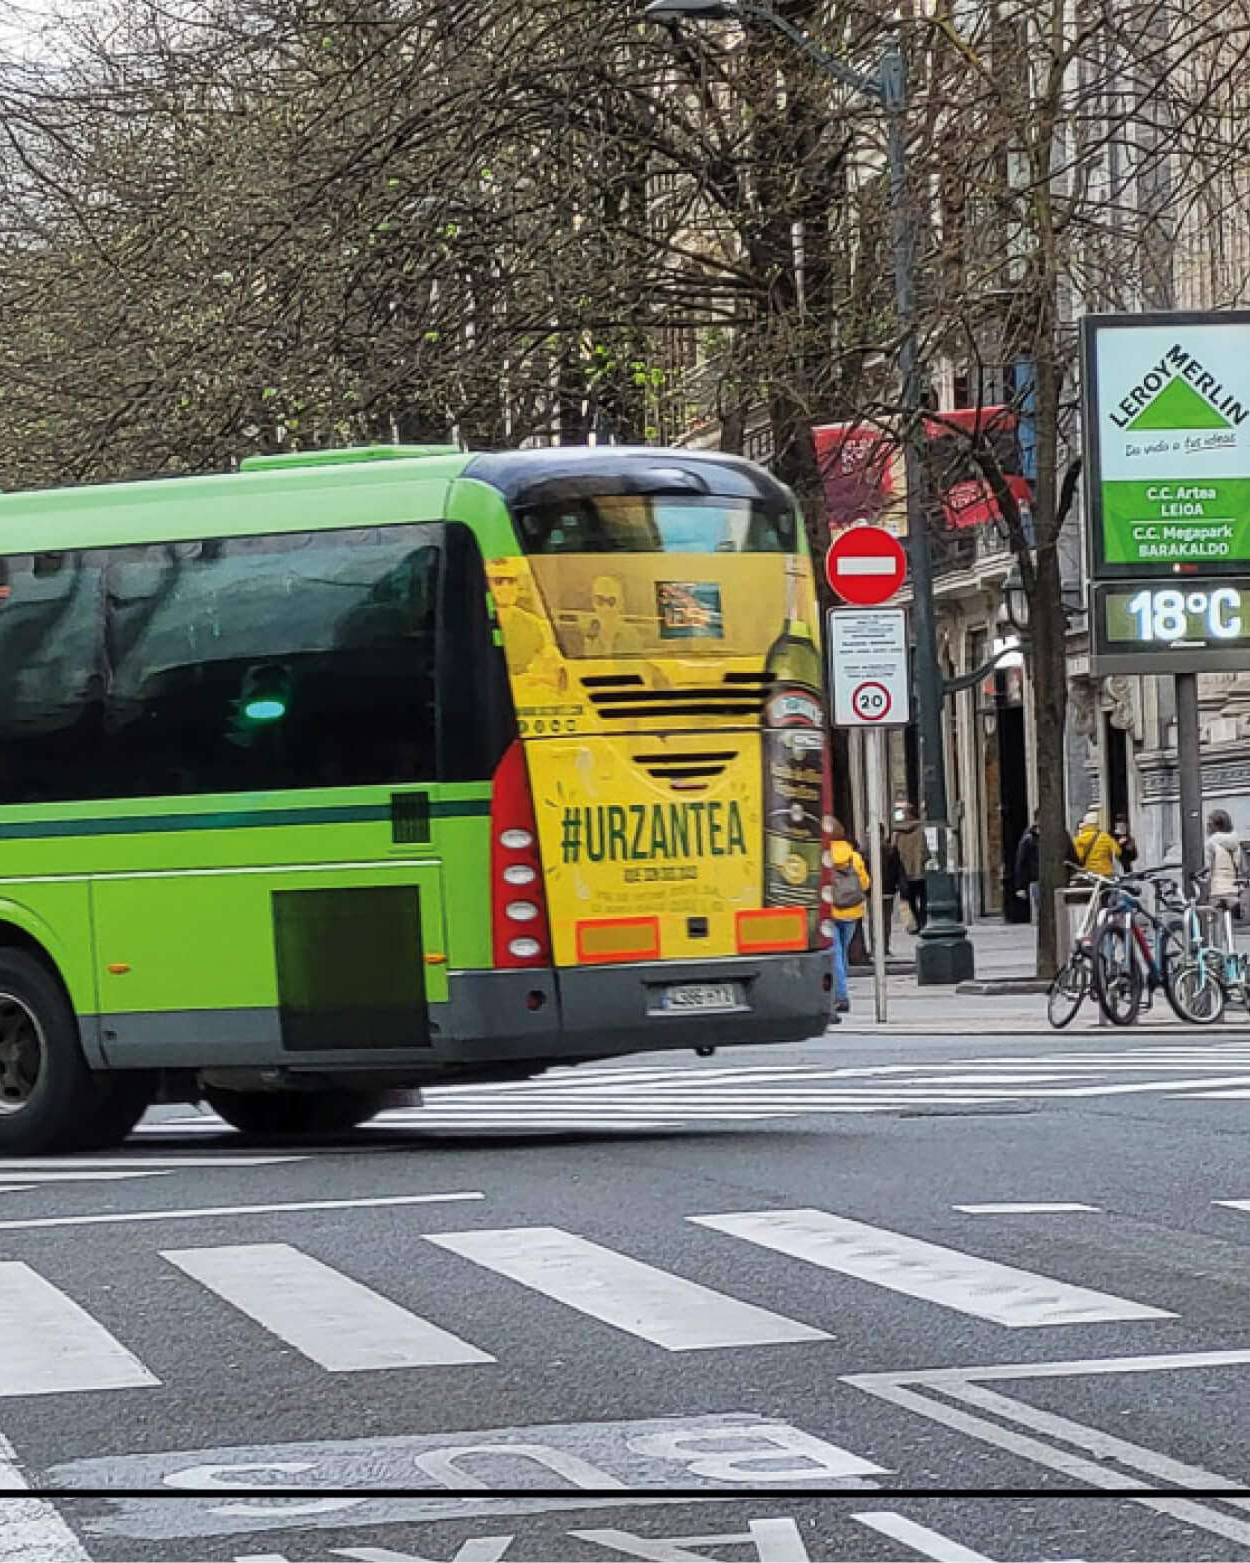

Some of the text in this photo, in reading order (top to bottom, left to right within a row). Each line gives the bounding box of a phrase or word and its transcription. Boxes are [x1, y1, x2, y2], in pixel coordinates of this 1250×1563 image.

[1109, 359, 1172, 429] LEROY
[1166, 344, 1250, 427] MERLIN
[1146, 486, 1216, 500] C.C. Artea
[1161, 502, 1204, 517] LEIOA
[1133, 524, 1233, 542] C.C. Megapark
[1139, 542, 1230, 558] BARAKALDO
[859, 694, 883, 709] 20
[561, 800, 747, 864] #URZANTEA
